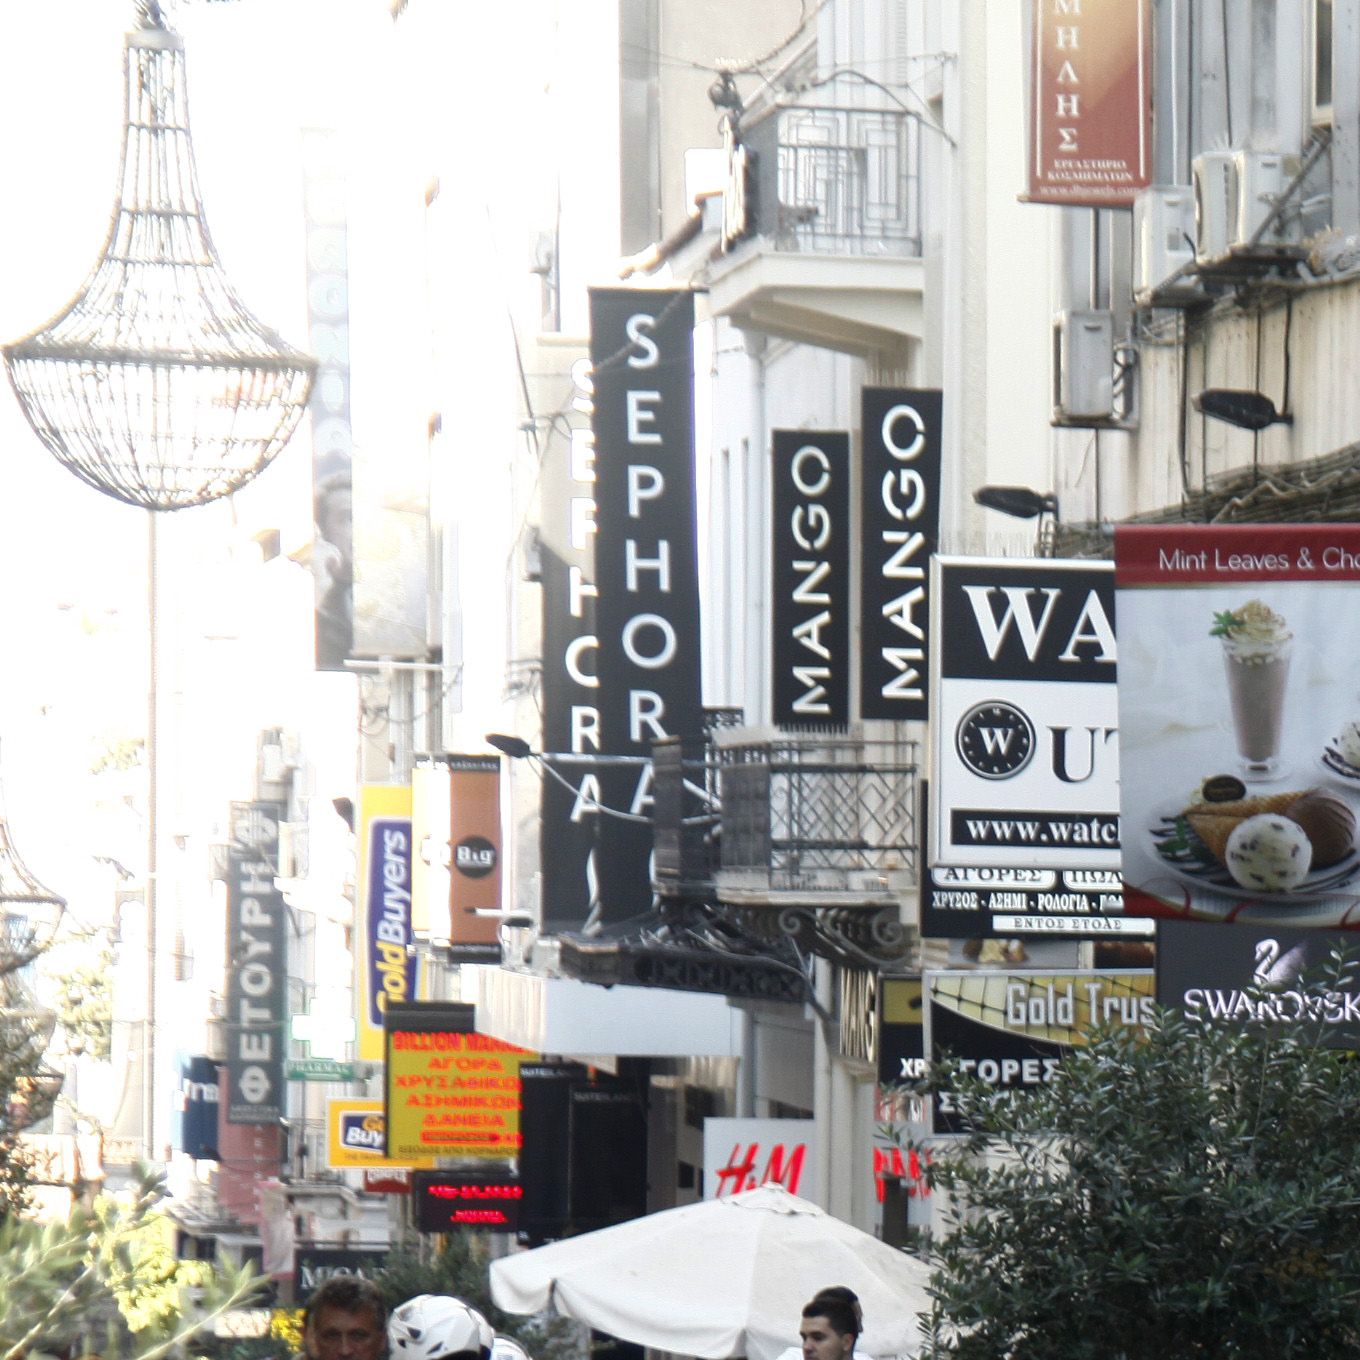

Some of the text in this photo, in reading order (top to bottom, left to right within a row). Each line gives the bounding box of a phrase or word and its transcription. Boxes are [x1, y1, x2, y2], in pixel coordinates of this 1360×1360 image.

[881, 403, 926, 699] MANGO
[1159, 548, 1207, 570] Mint
[1215, 548, 1289, 571] Leaves
[791, 444, 832, 713] MANGO
[966, 817, 1121, 844] www.watc
[932, 891, 980, 911] ΧΡΥΣΟΣ
[988, 892, 1029, 911] ΑΣΗΜΙ
[1037, 893, 1090, 912] ΡΟΛΟΓΙΑ
[1014, 917, 1122, 930] ΕΝΤΟΣ ΣΤΟΑΣ
[1006, 982, 1075, 1027] Gold
[957, 1058, 1060, 1085] ΓΟΡΕΣ
